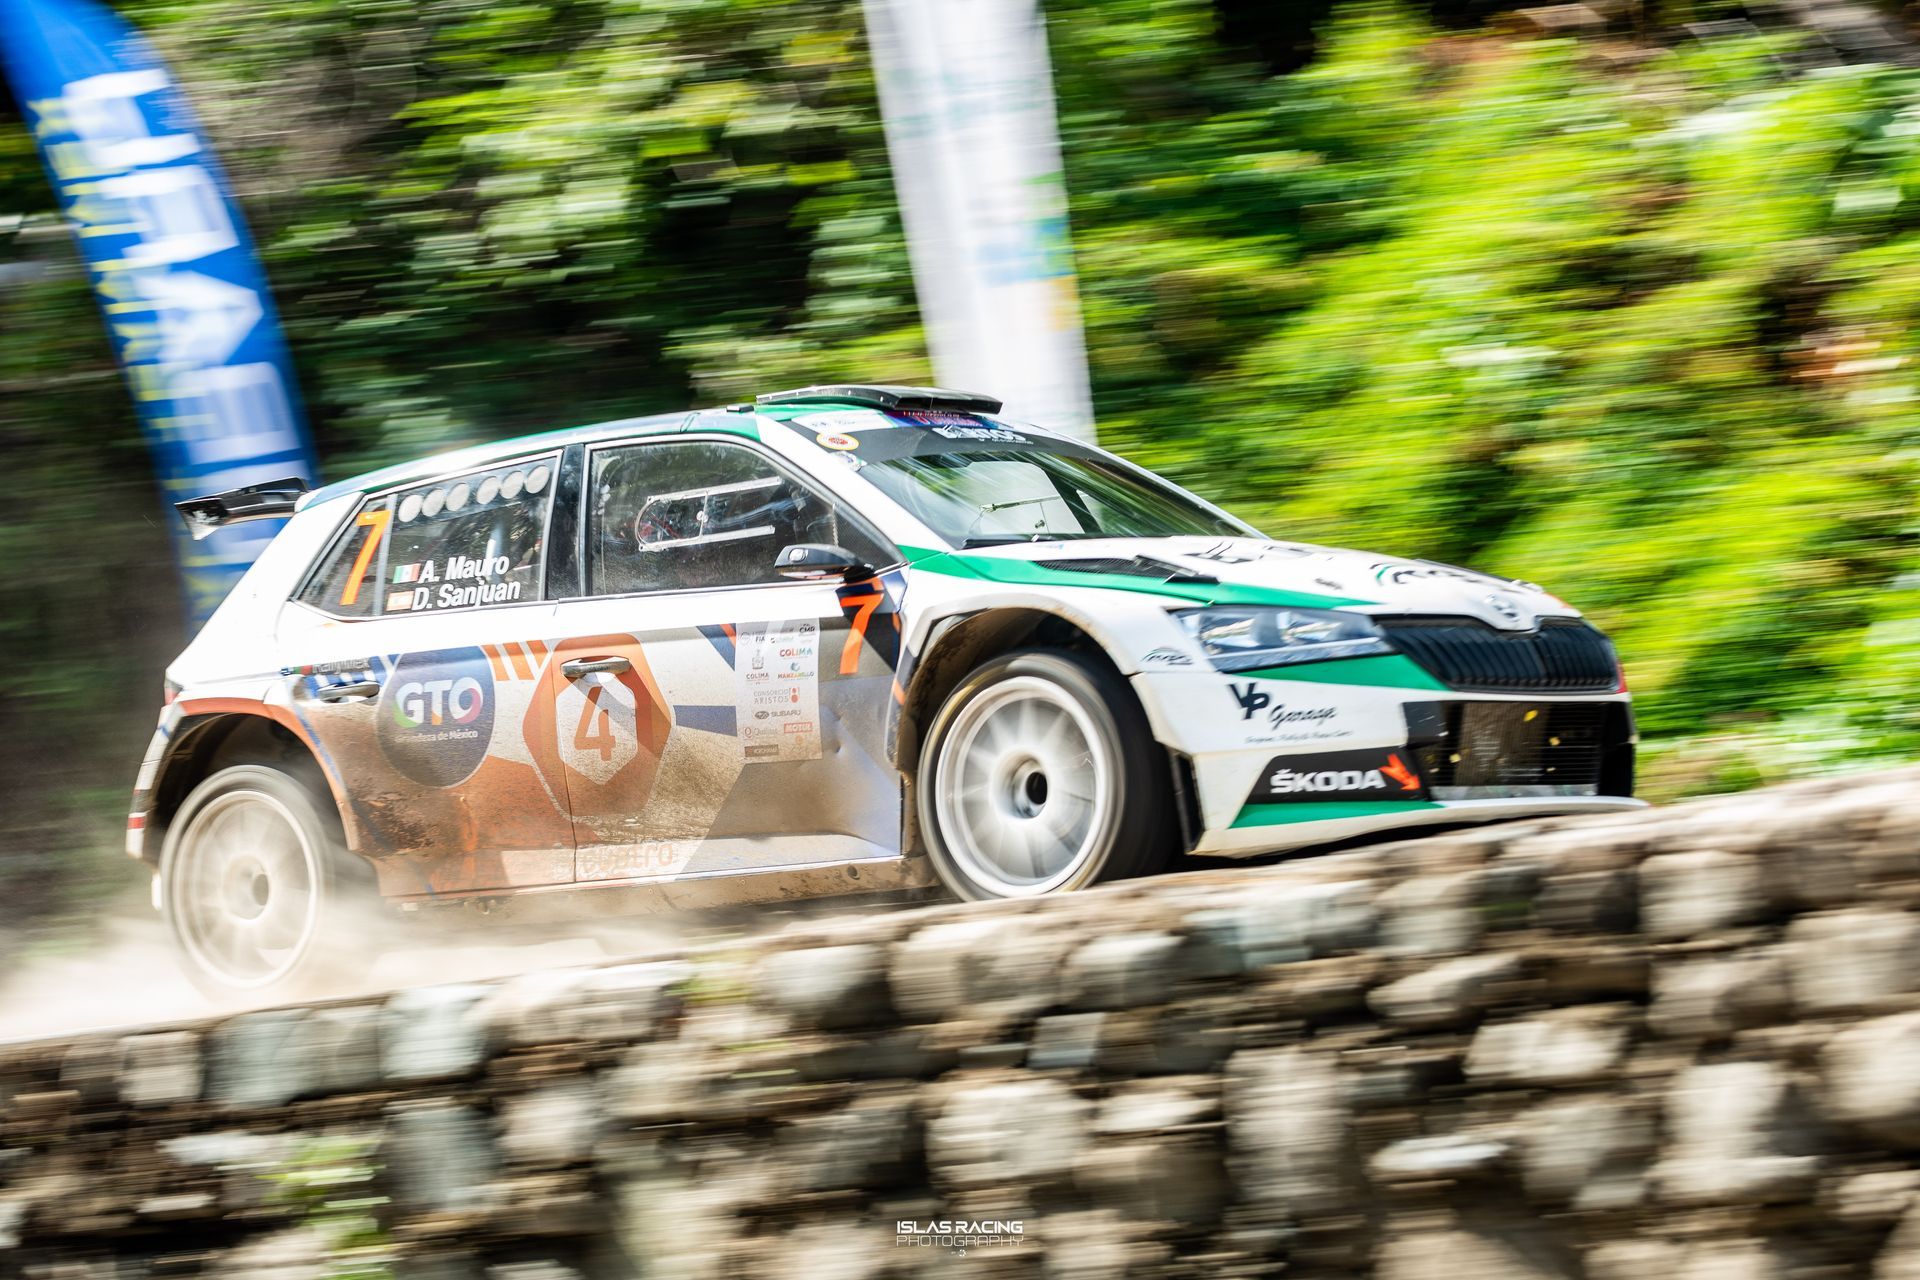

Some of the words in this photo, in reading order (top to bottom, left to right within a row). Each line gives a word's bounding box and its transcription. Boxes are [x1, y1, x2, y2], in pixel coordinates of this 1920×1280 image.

[340, 510, 390, 605] 7
[418, 560, 439, 584] A.
[445, 555, 509, 581] Mauro
[412, 587, 432, 611] D.
[437, 578, 521, 607] Sanjuan
[840, 593, 884, 674] 7
[780, 648, 812, 657] COLIMA
[393, 677, 483, 728] GTO
[753, 696, 789, 705] ARISTOS
[770, 709, 801, 718] SUBARU
[1227, 682, 1270, 720] VP
[1268, 704, 1337, 730] Garage
[437, 731, 448, 741] de
[449, 729, 478, 740] México
[574, 686, 616, 761] 4
[1270, 768, 1387, 794] ŠKODA
